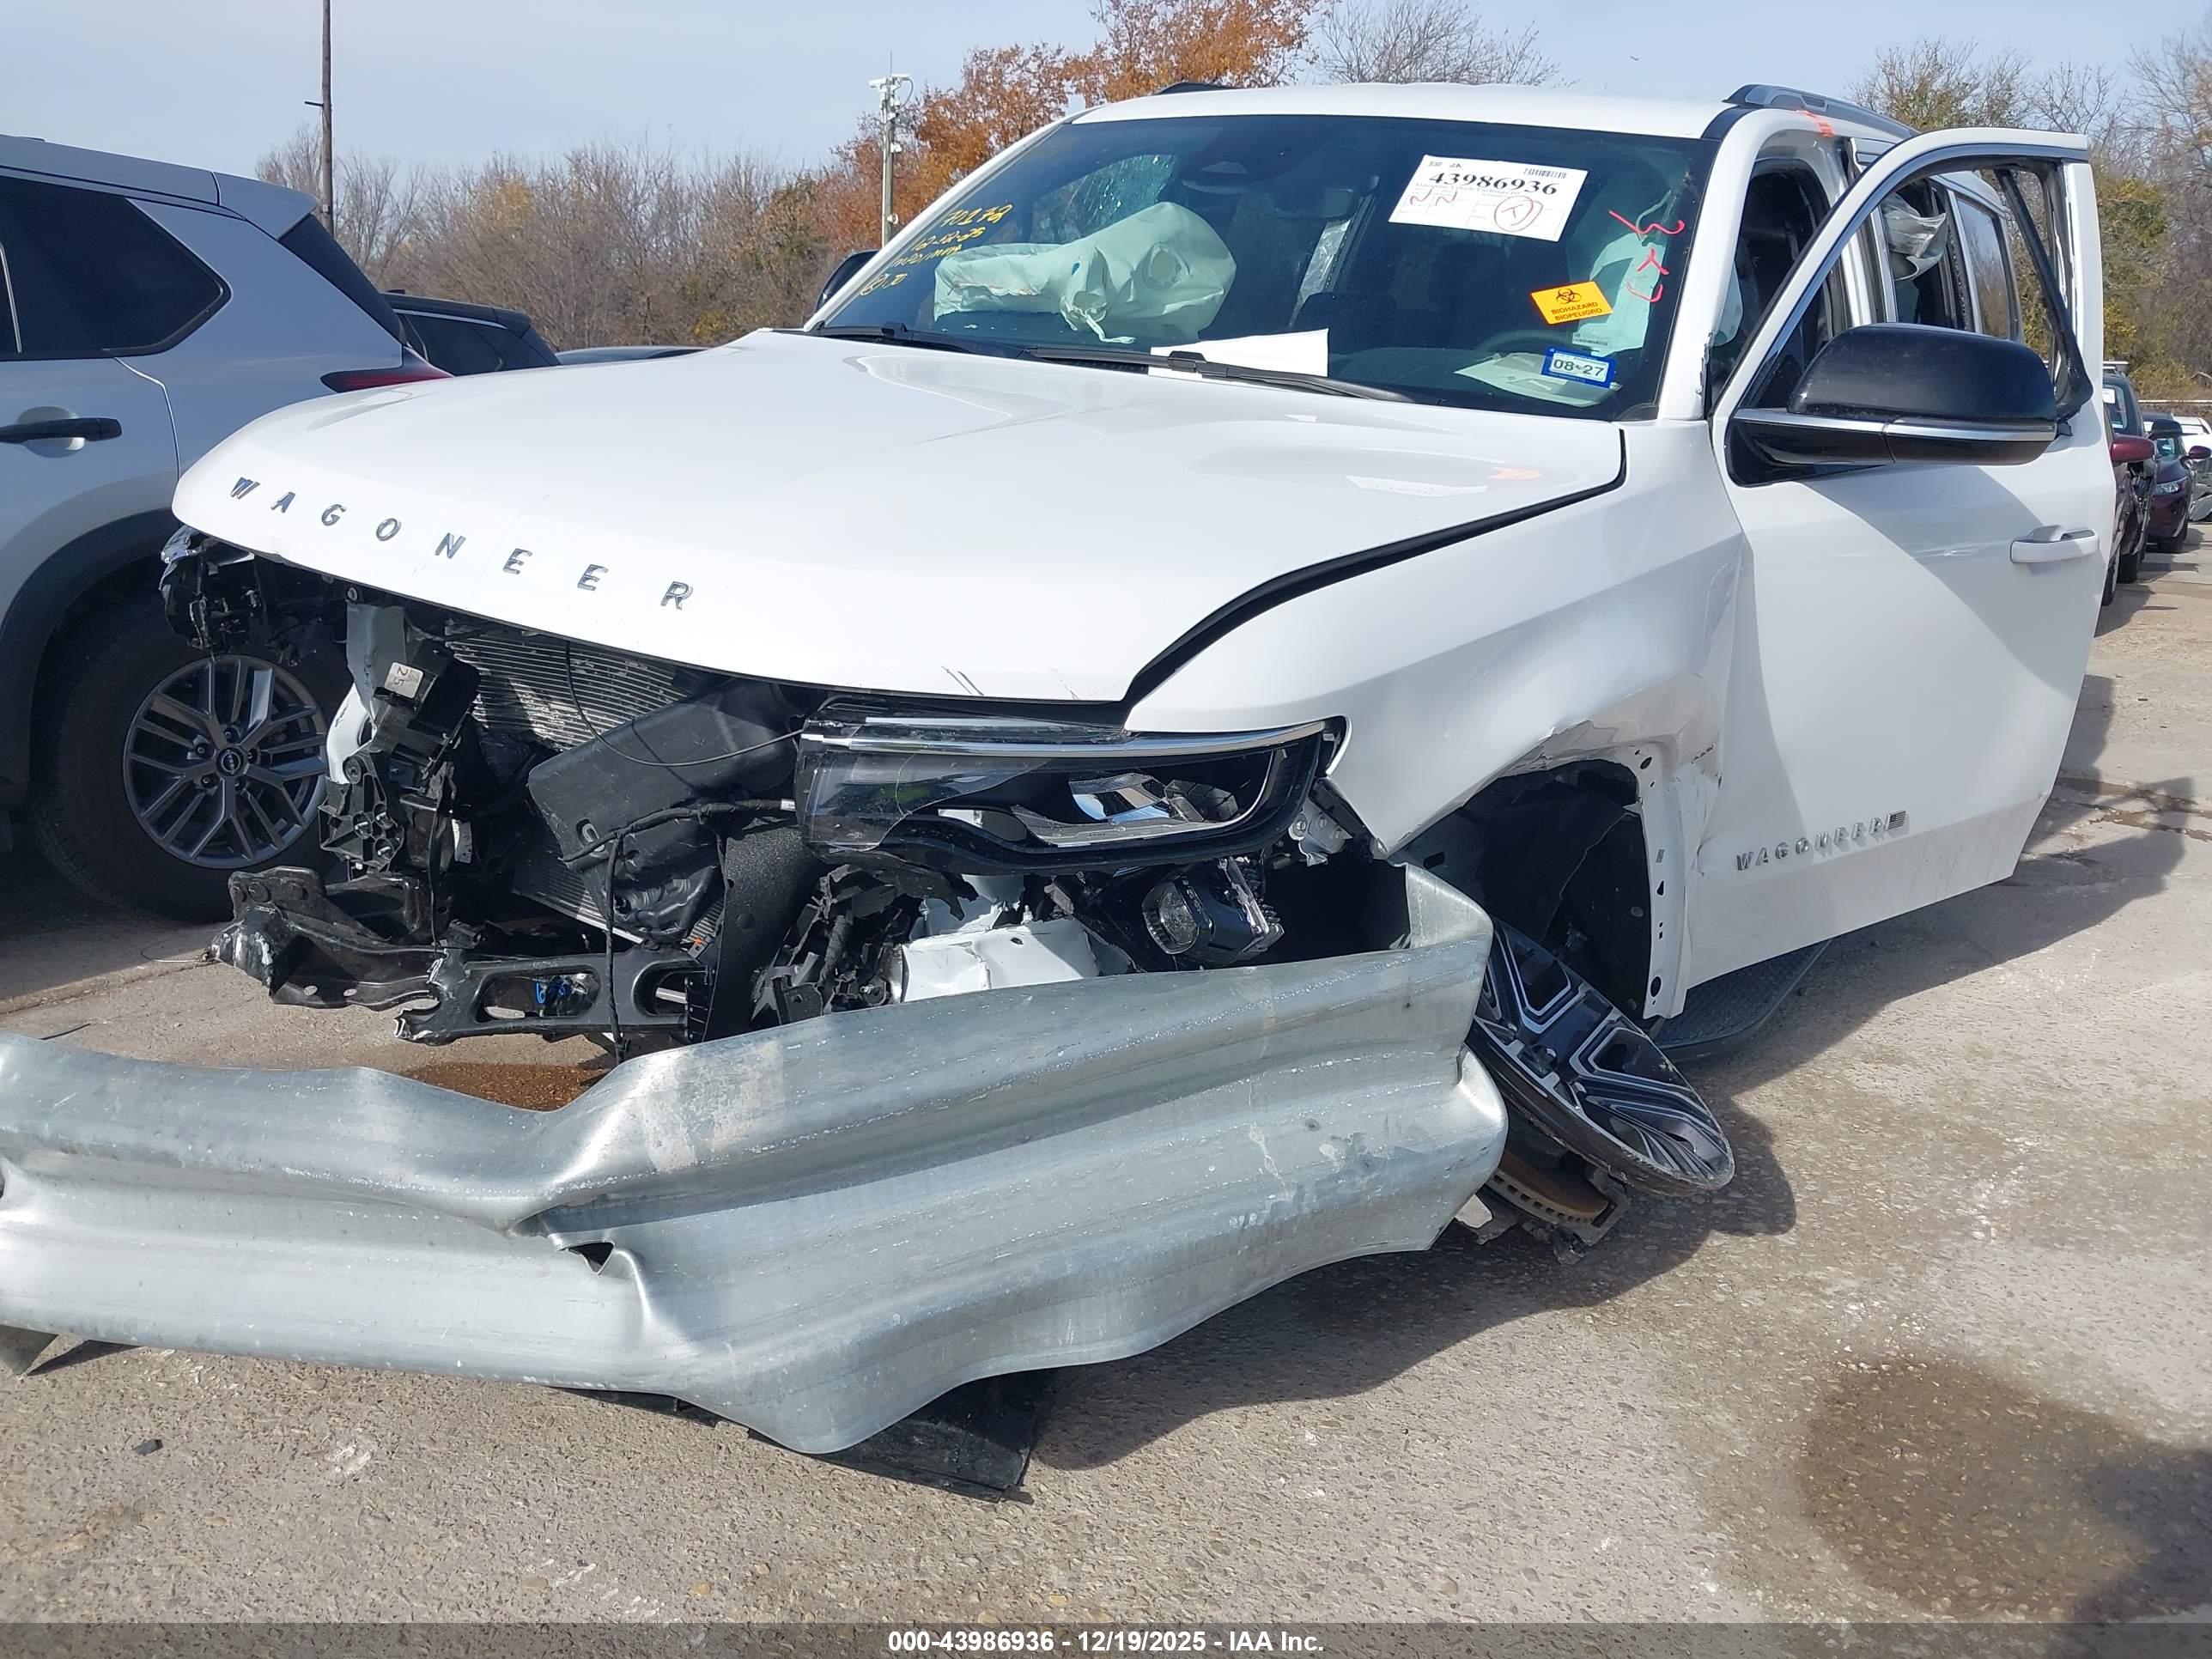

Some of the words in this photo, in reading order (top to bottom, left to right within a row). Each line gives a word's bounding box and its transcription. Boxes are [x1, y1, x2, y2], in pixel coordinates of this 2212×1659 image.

[1429, 172, 1560, 195] 43986936
[1551, 301, 1599, 315] BIOHAZARD
[1555, 307, 1602, 321] BIOPELIGRO
[230, 477, 694, 611] WAGONEER
[1736, 817, 1884, 872] WAGONEER
